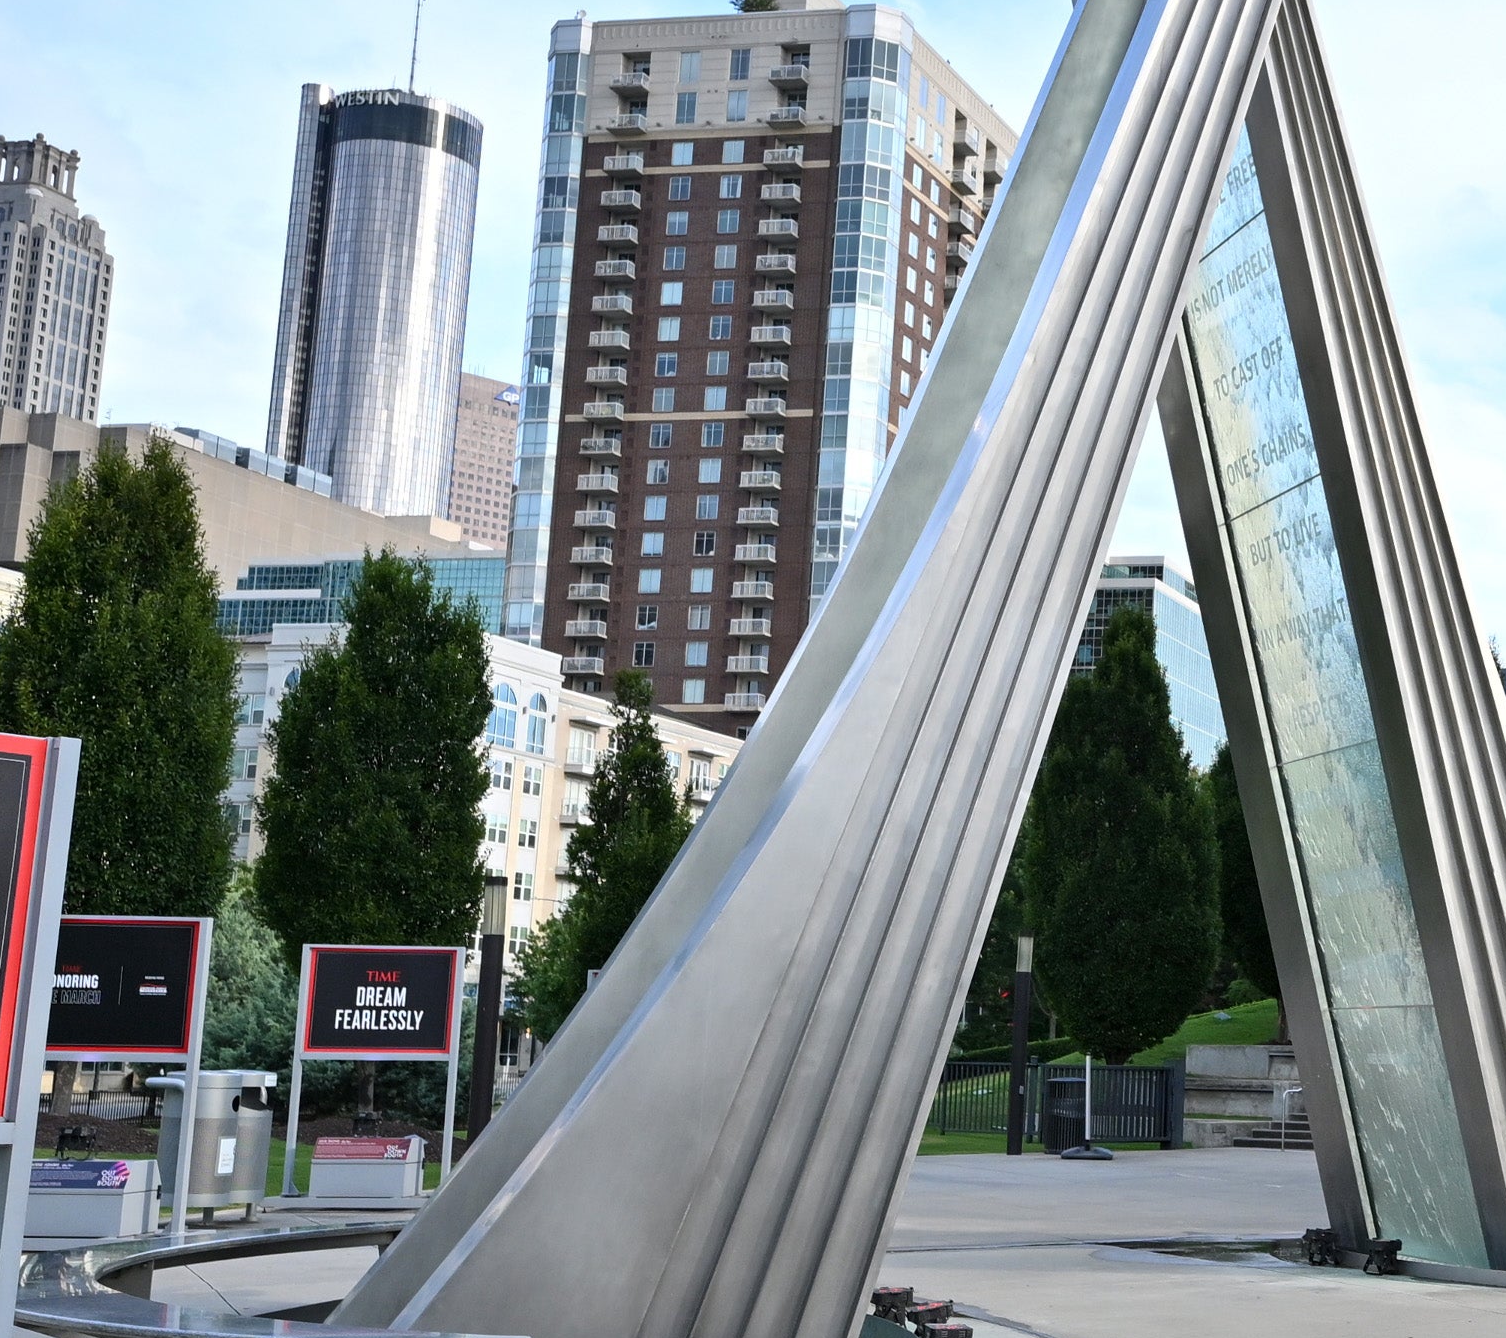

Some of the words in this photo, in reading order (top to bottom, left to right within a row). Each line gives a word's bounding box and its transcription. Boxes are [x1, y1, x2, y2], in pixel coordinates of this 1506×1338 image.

[335, 92, 399, 108] WESTIN
[1202, 279, 1226, 313] NOT
[1227, 243, 1272, 296] MERELY
[1213, 377, 1230, 401] TO
[1231, 353, 1258, 389] CAST
[1261, 336, 1283, 369] OFF
[503, 391, 519, 403] GP
[1227, 449, 1260, 486] ONE'S
[1250, 537, 1273, 566] BUT
[1274, 527, 1291, 553] TO
[1295, 513, 1322, 548] LIVE
[1276, 623, 1286, 643] A
[1286, 612, 1312, 642] WAY
[1313, 598, 1346, 632] THAT
[366, 971, 401, 982] TIME
[61, 990, 101, 1005] MARCH
[356, 986, 407, 1007] DREAM
[335, 1009, 424, 1030] FEARLESSLY
